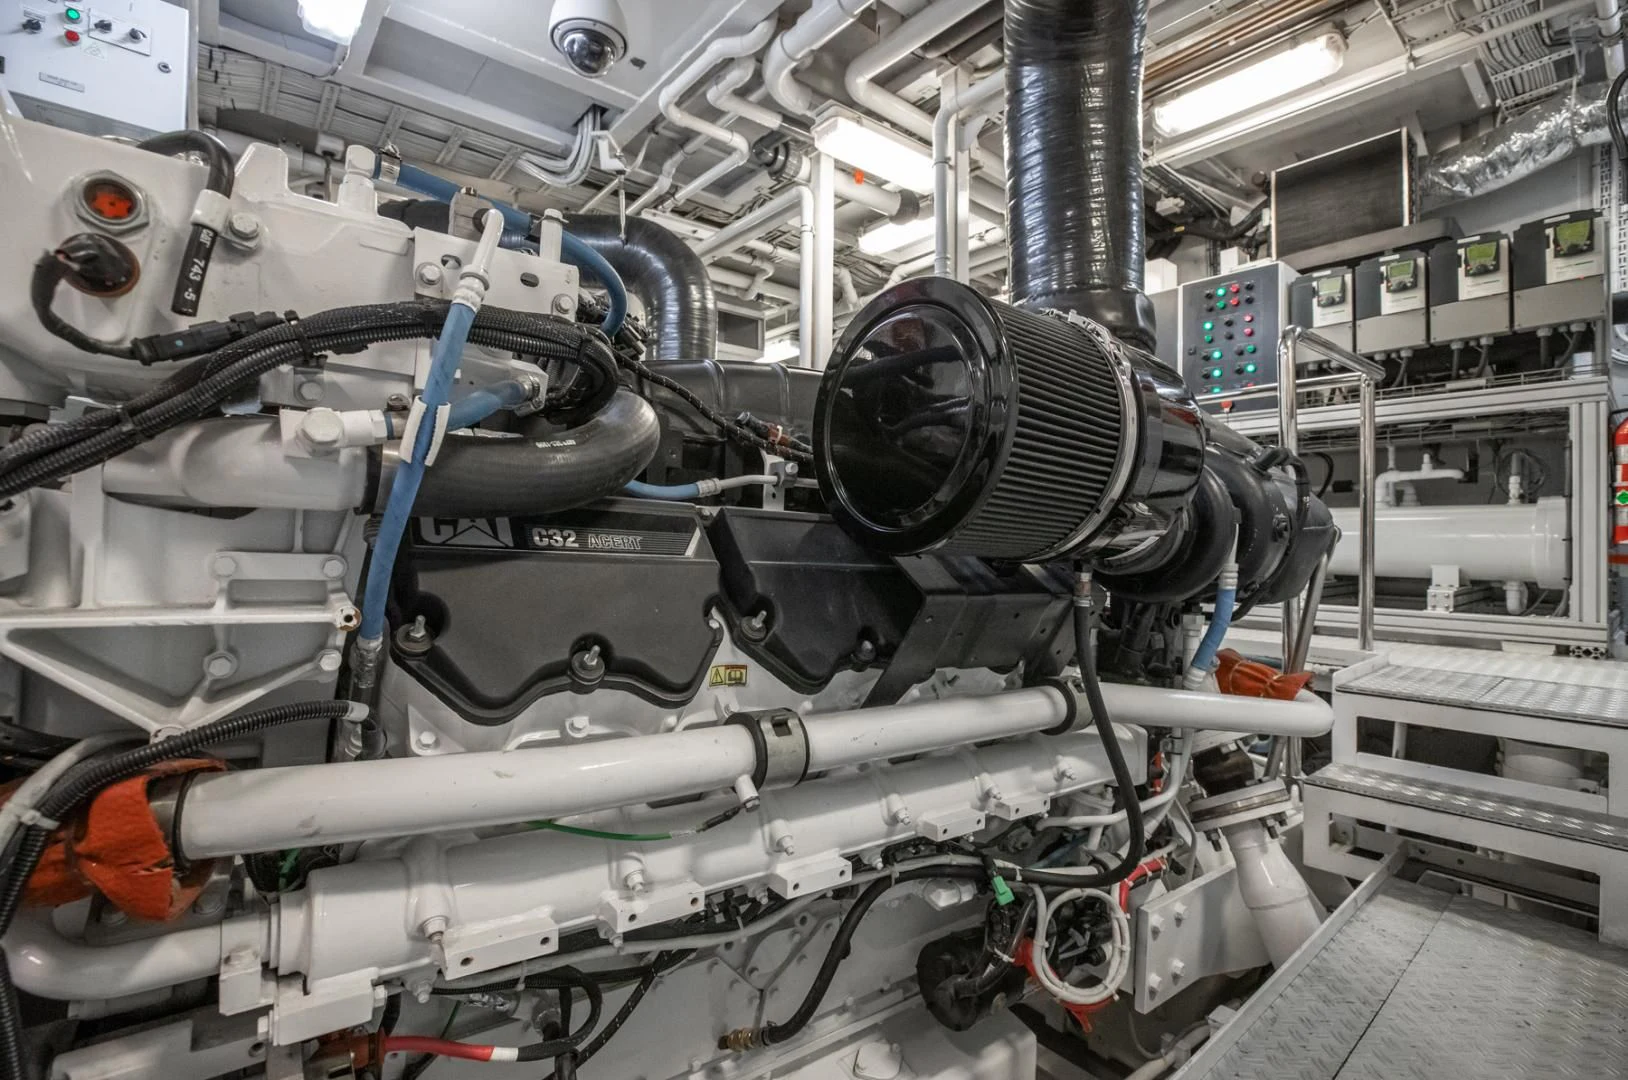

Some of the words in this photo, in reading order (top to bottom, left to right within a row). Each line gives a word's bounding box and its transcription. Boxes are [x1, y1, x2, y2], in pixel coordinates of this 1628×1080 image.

[199, 228, 214, 248] CAT
[189, 258, 205, 281] 743
[531, 527, 580, 548] C32
[588, 533, 644, 550] ACERT
